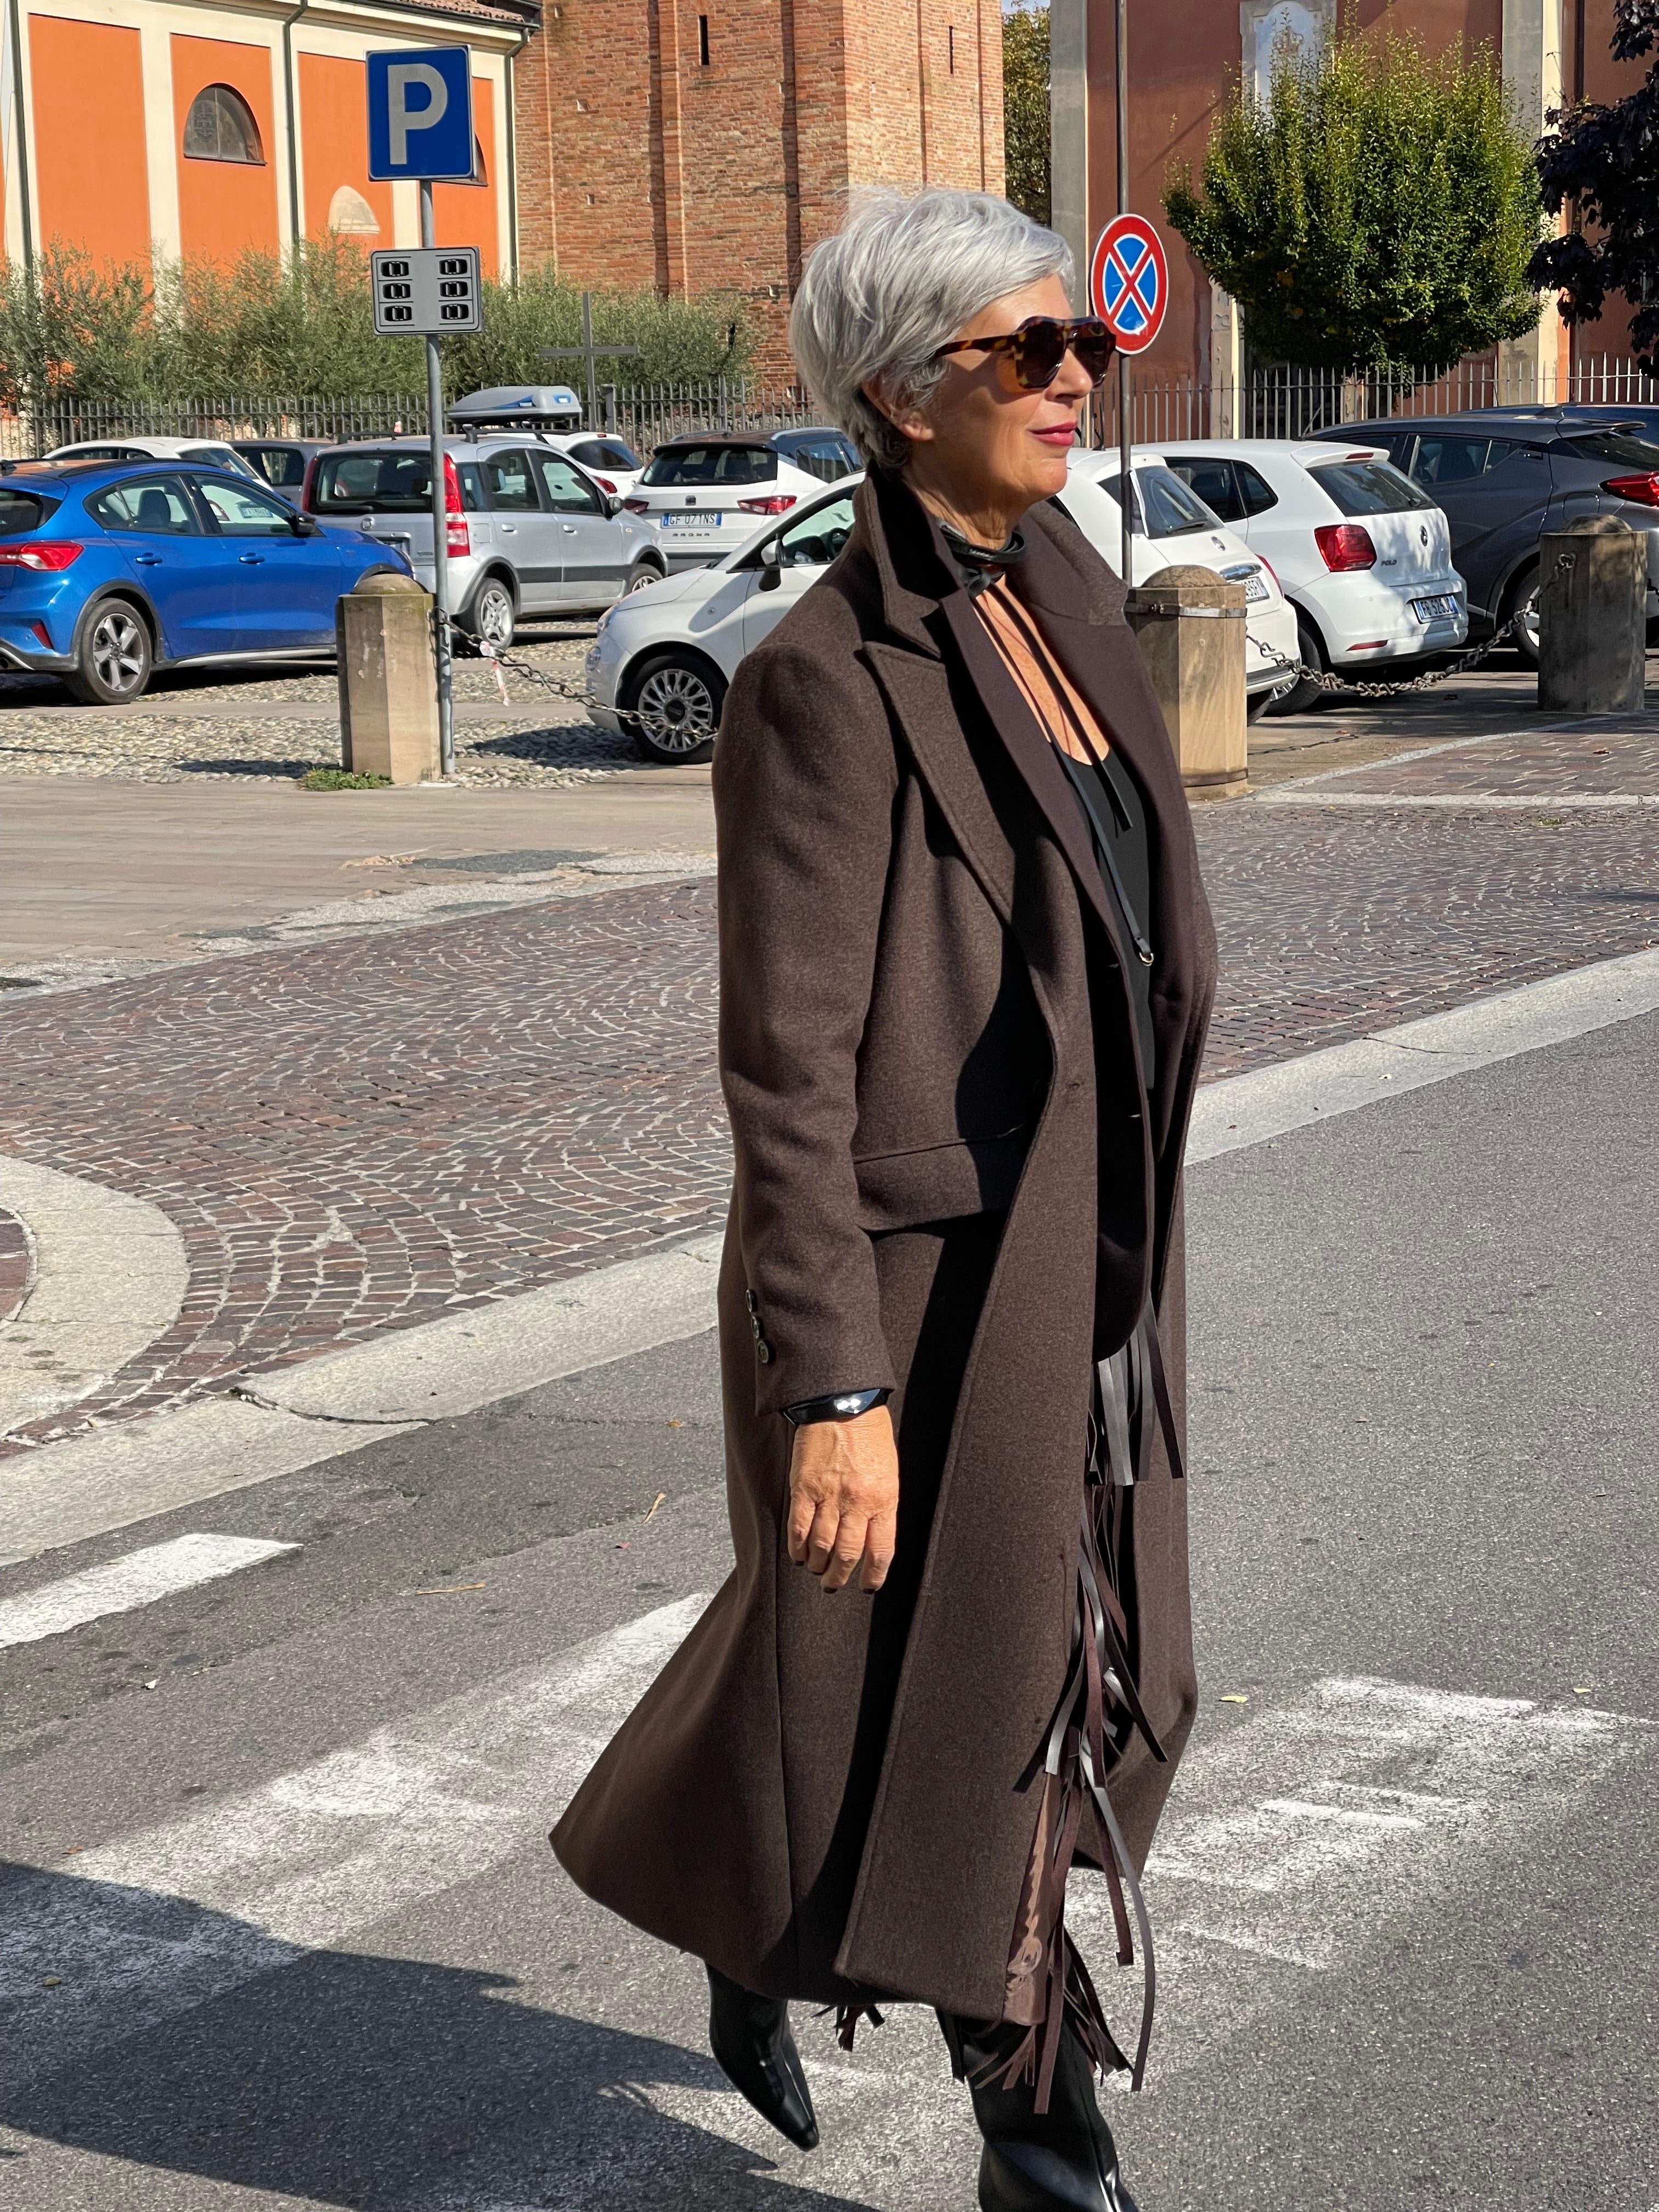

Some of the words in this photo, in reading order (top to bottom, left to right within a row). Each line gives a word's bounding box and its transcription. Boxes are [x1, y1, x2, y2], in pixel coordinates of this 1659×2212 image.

[387, 63, 448, 165] P
[669, 514, 681, 524] GF
[685, 514, 715, 524] 071NS
